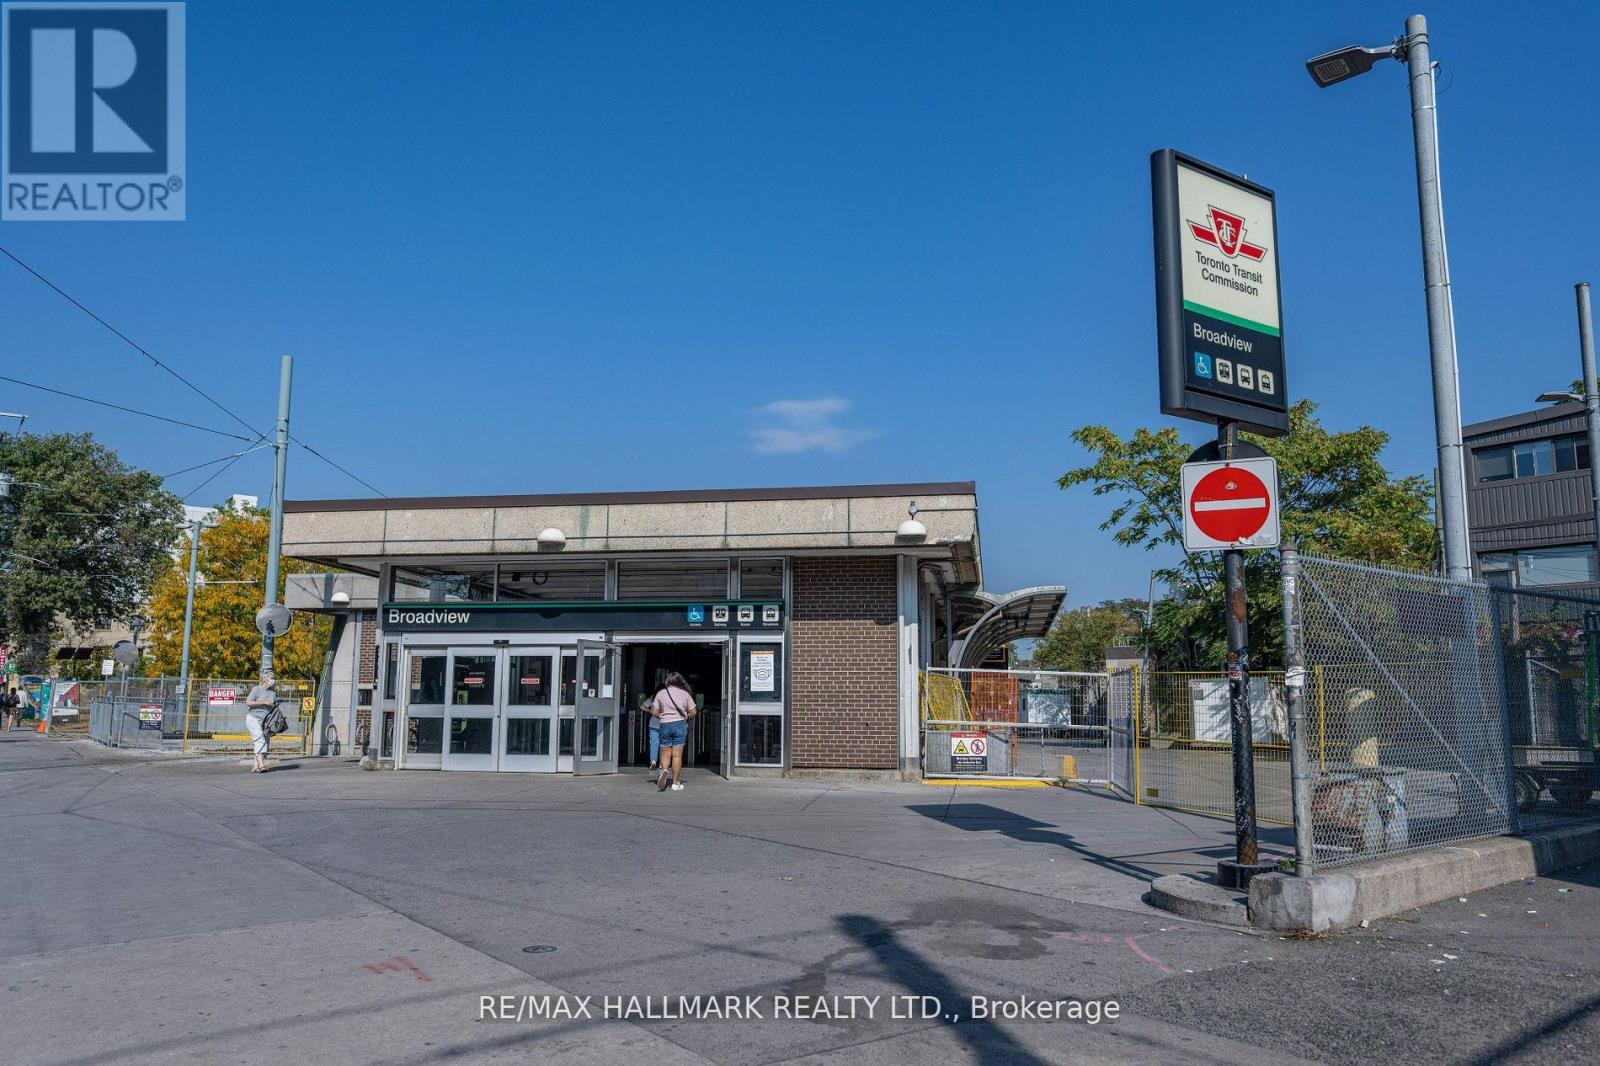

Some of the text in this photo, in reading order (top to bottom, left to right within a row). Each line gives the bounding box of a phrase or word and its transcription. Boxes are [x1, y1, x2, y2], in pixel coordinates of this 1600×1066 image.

[1195, 251, 1263, 284] Toronto Transit
[1201, 268, 1259, 297] Commission
[1193, 322, 1253, 353] Broadview
[388, 608, 471, 624] Broadview
